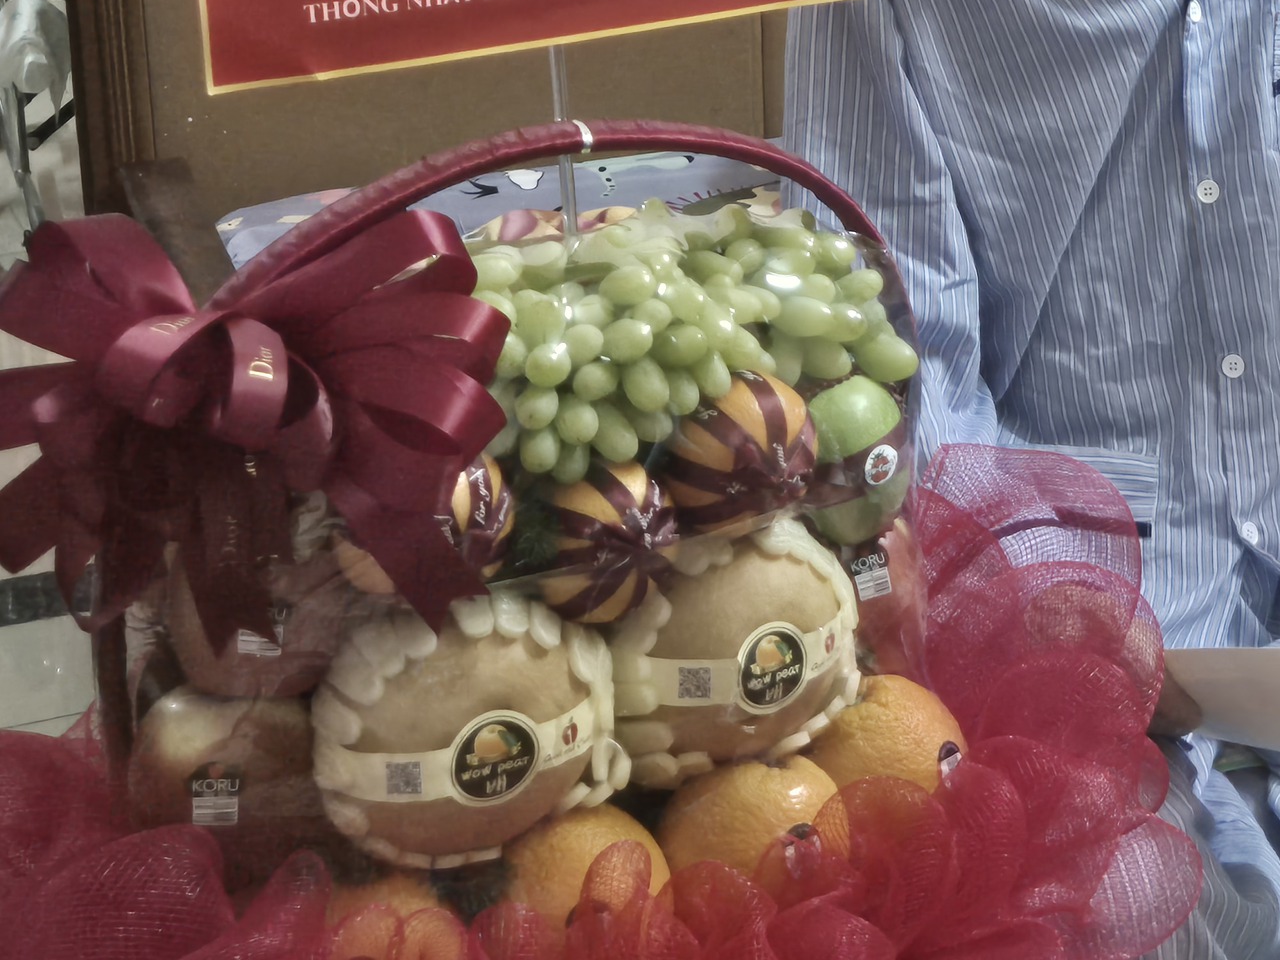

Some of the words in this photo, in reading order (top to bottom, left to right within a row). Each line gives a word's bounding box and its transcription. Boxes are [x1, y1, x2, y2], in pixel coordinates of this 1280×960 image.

[249, 345, 274, 381] Dior
[850, 552, 886, 573] KORU
[192, 778, 239, 792] KORU
